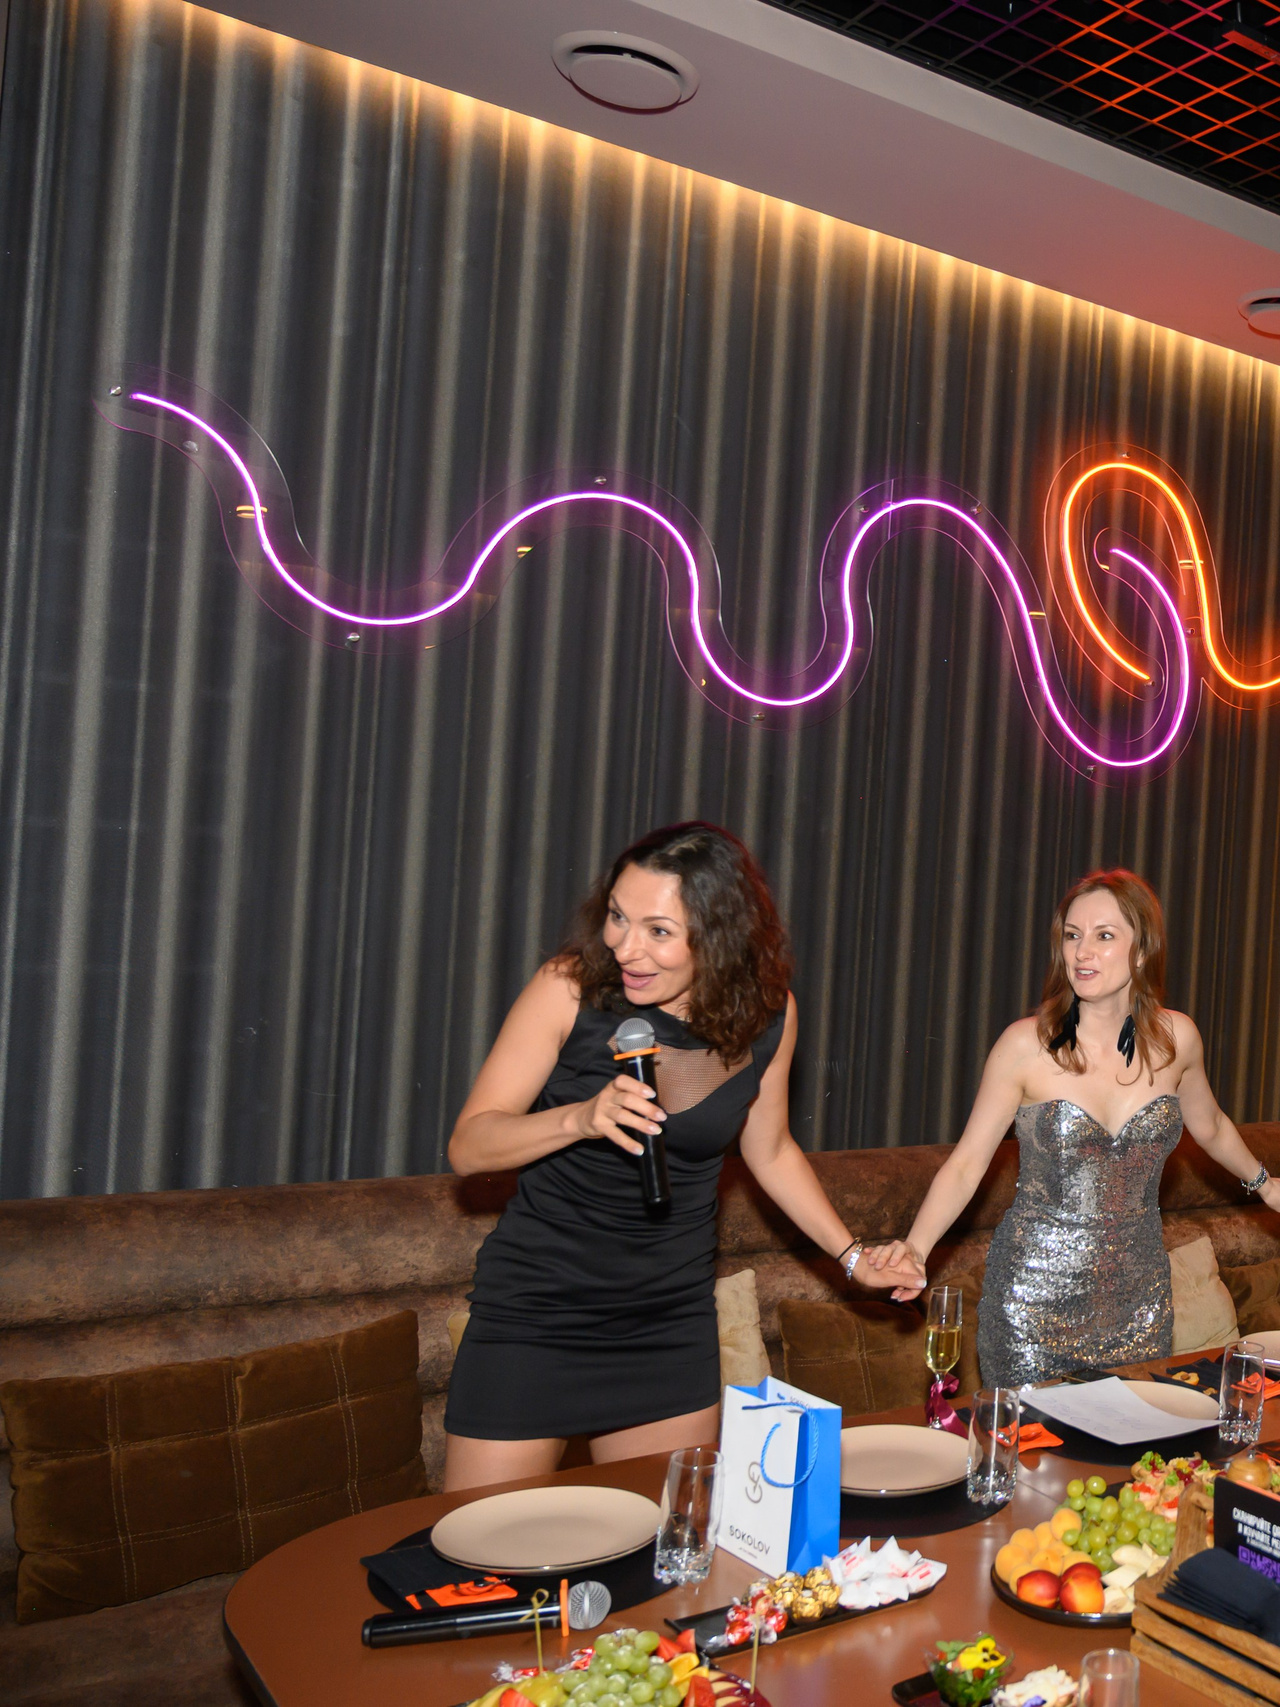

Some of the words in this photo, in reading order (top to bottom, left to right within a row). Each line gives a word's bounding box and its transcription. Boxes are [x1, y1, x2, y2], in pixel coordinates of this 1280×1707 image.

[1232, 1507, 1272, 1535] СКАНИРУЙТЕ
[729, 1525, 770, 1555] SOKOLOV
[1243, 1524, 1271, 1547] ИЗУЧАЙТЕ
